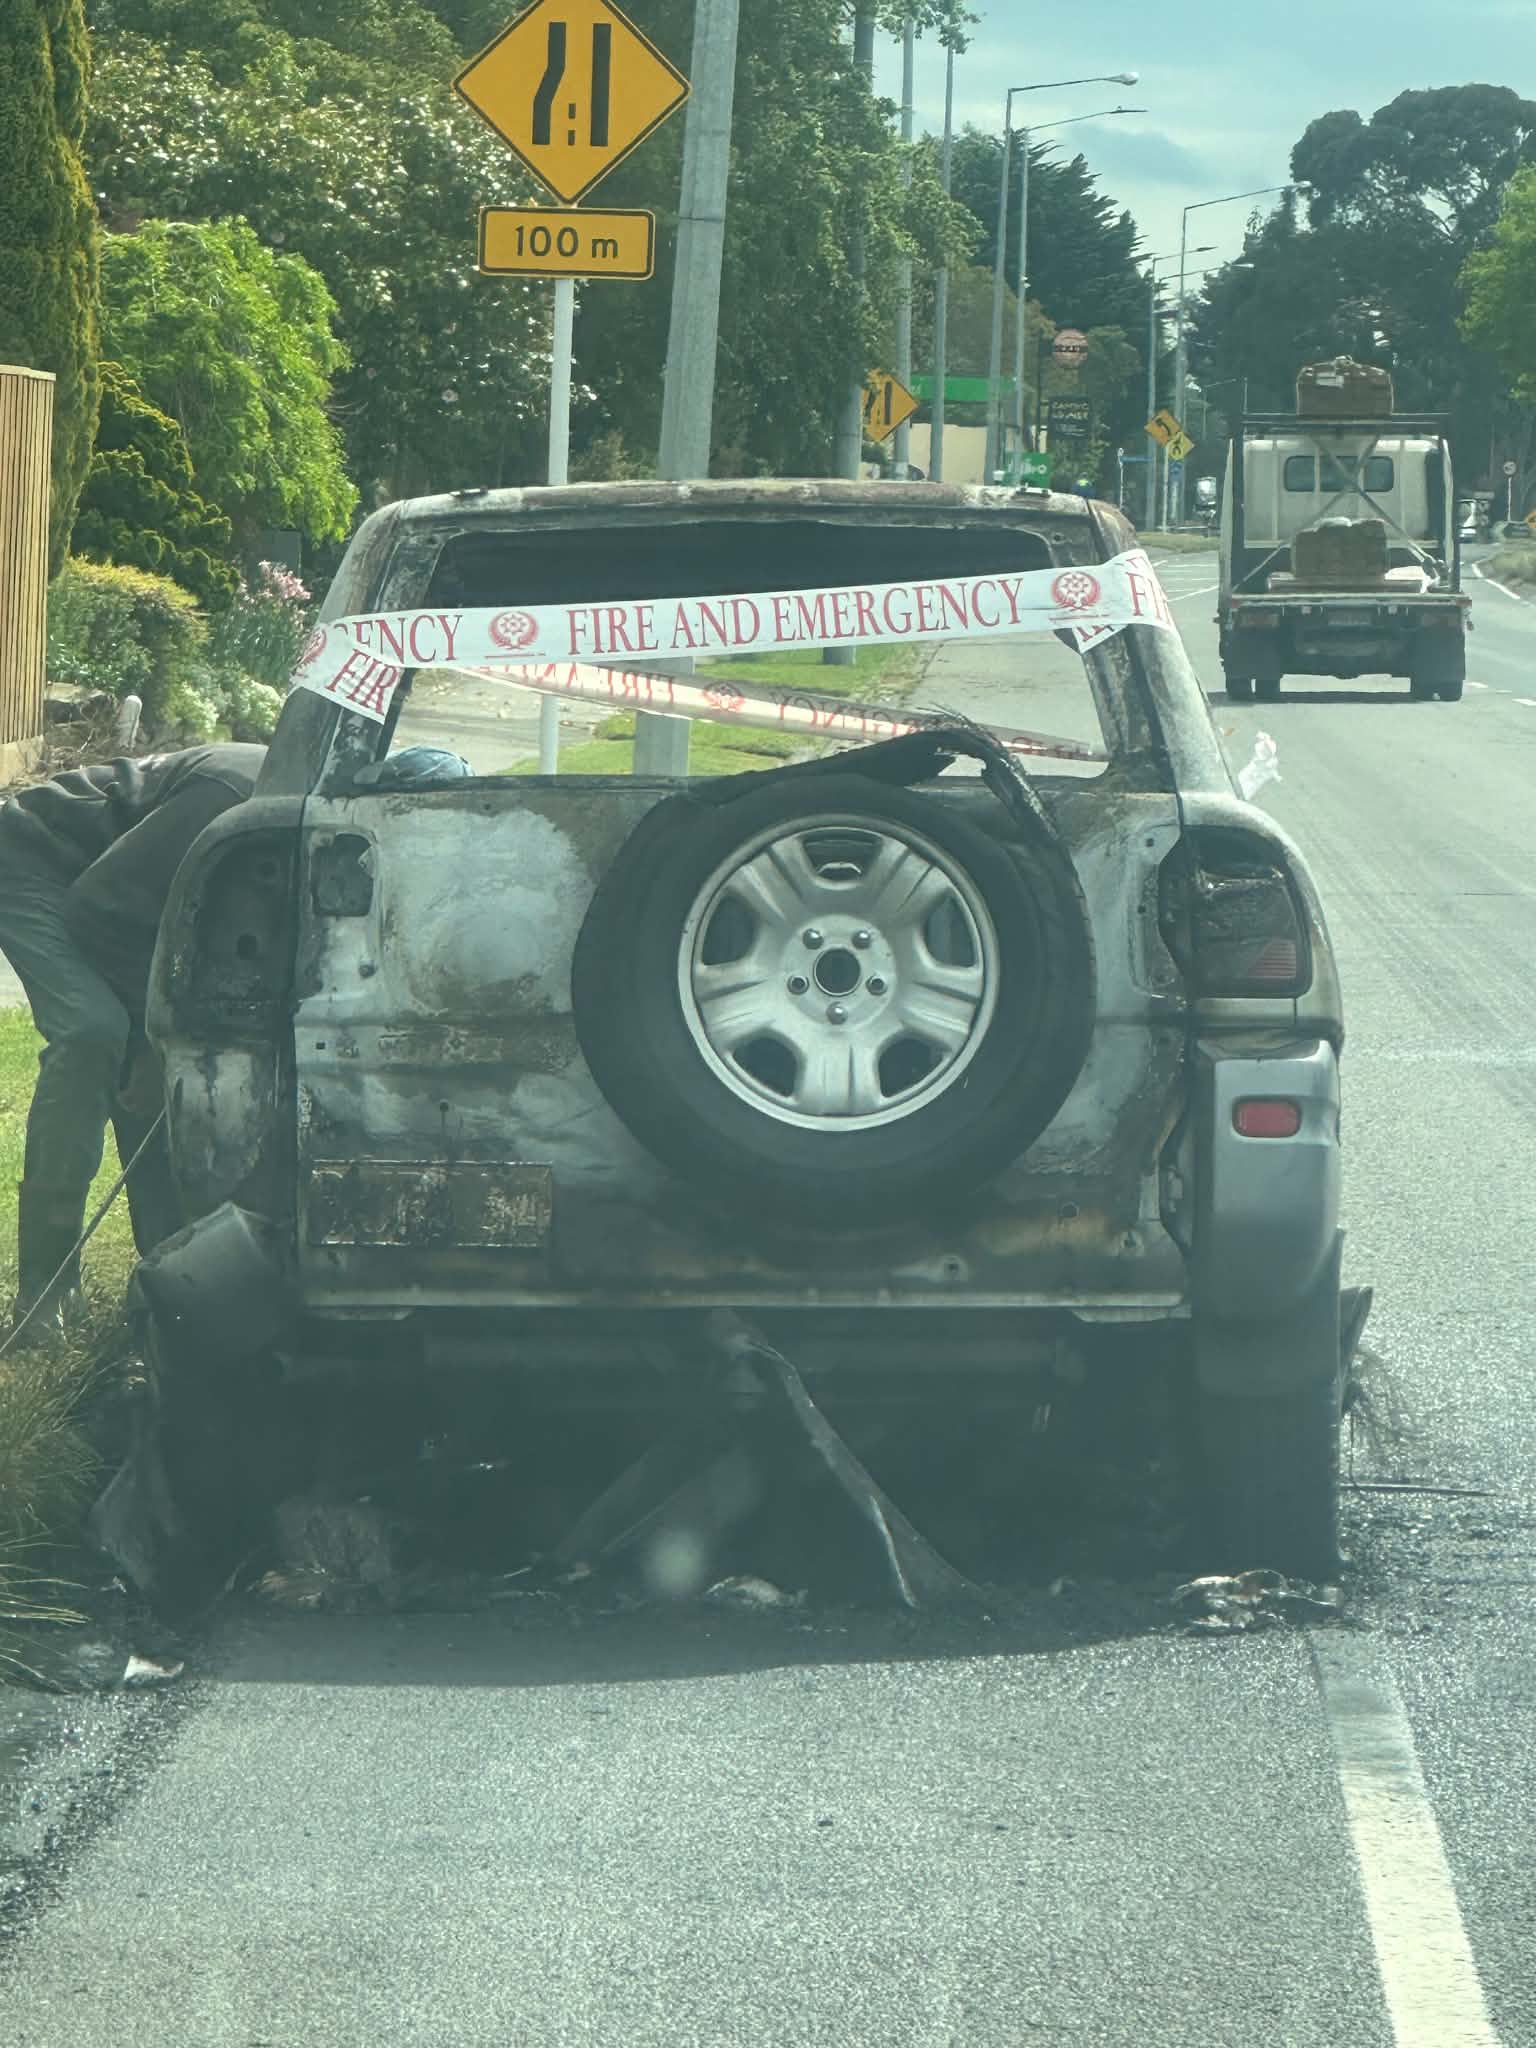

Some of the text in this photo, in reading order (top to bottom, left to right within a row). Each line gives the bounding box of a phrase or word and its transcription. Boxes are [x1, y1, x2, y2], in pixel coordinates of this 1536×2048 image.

[515, 225, 619, 259] 100 m
[333, 614, 463, 664] ENCY
[566, 605, 659, 655] FIRE
[669, 597, 761, 649] AND
[770, 578, 1024, 642] EMERGENCY
